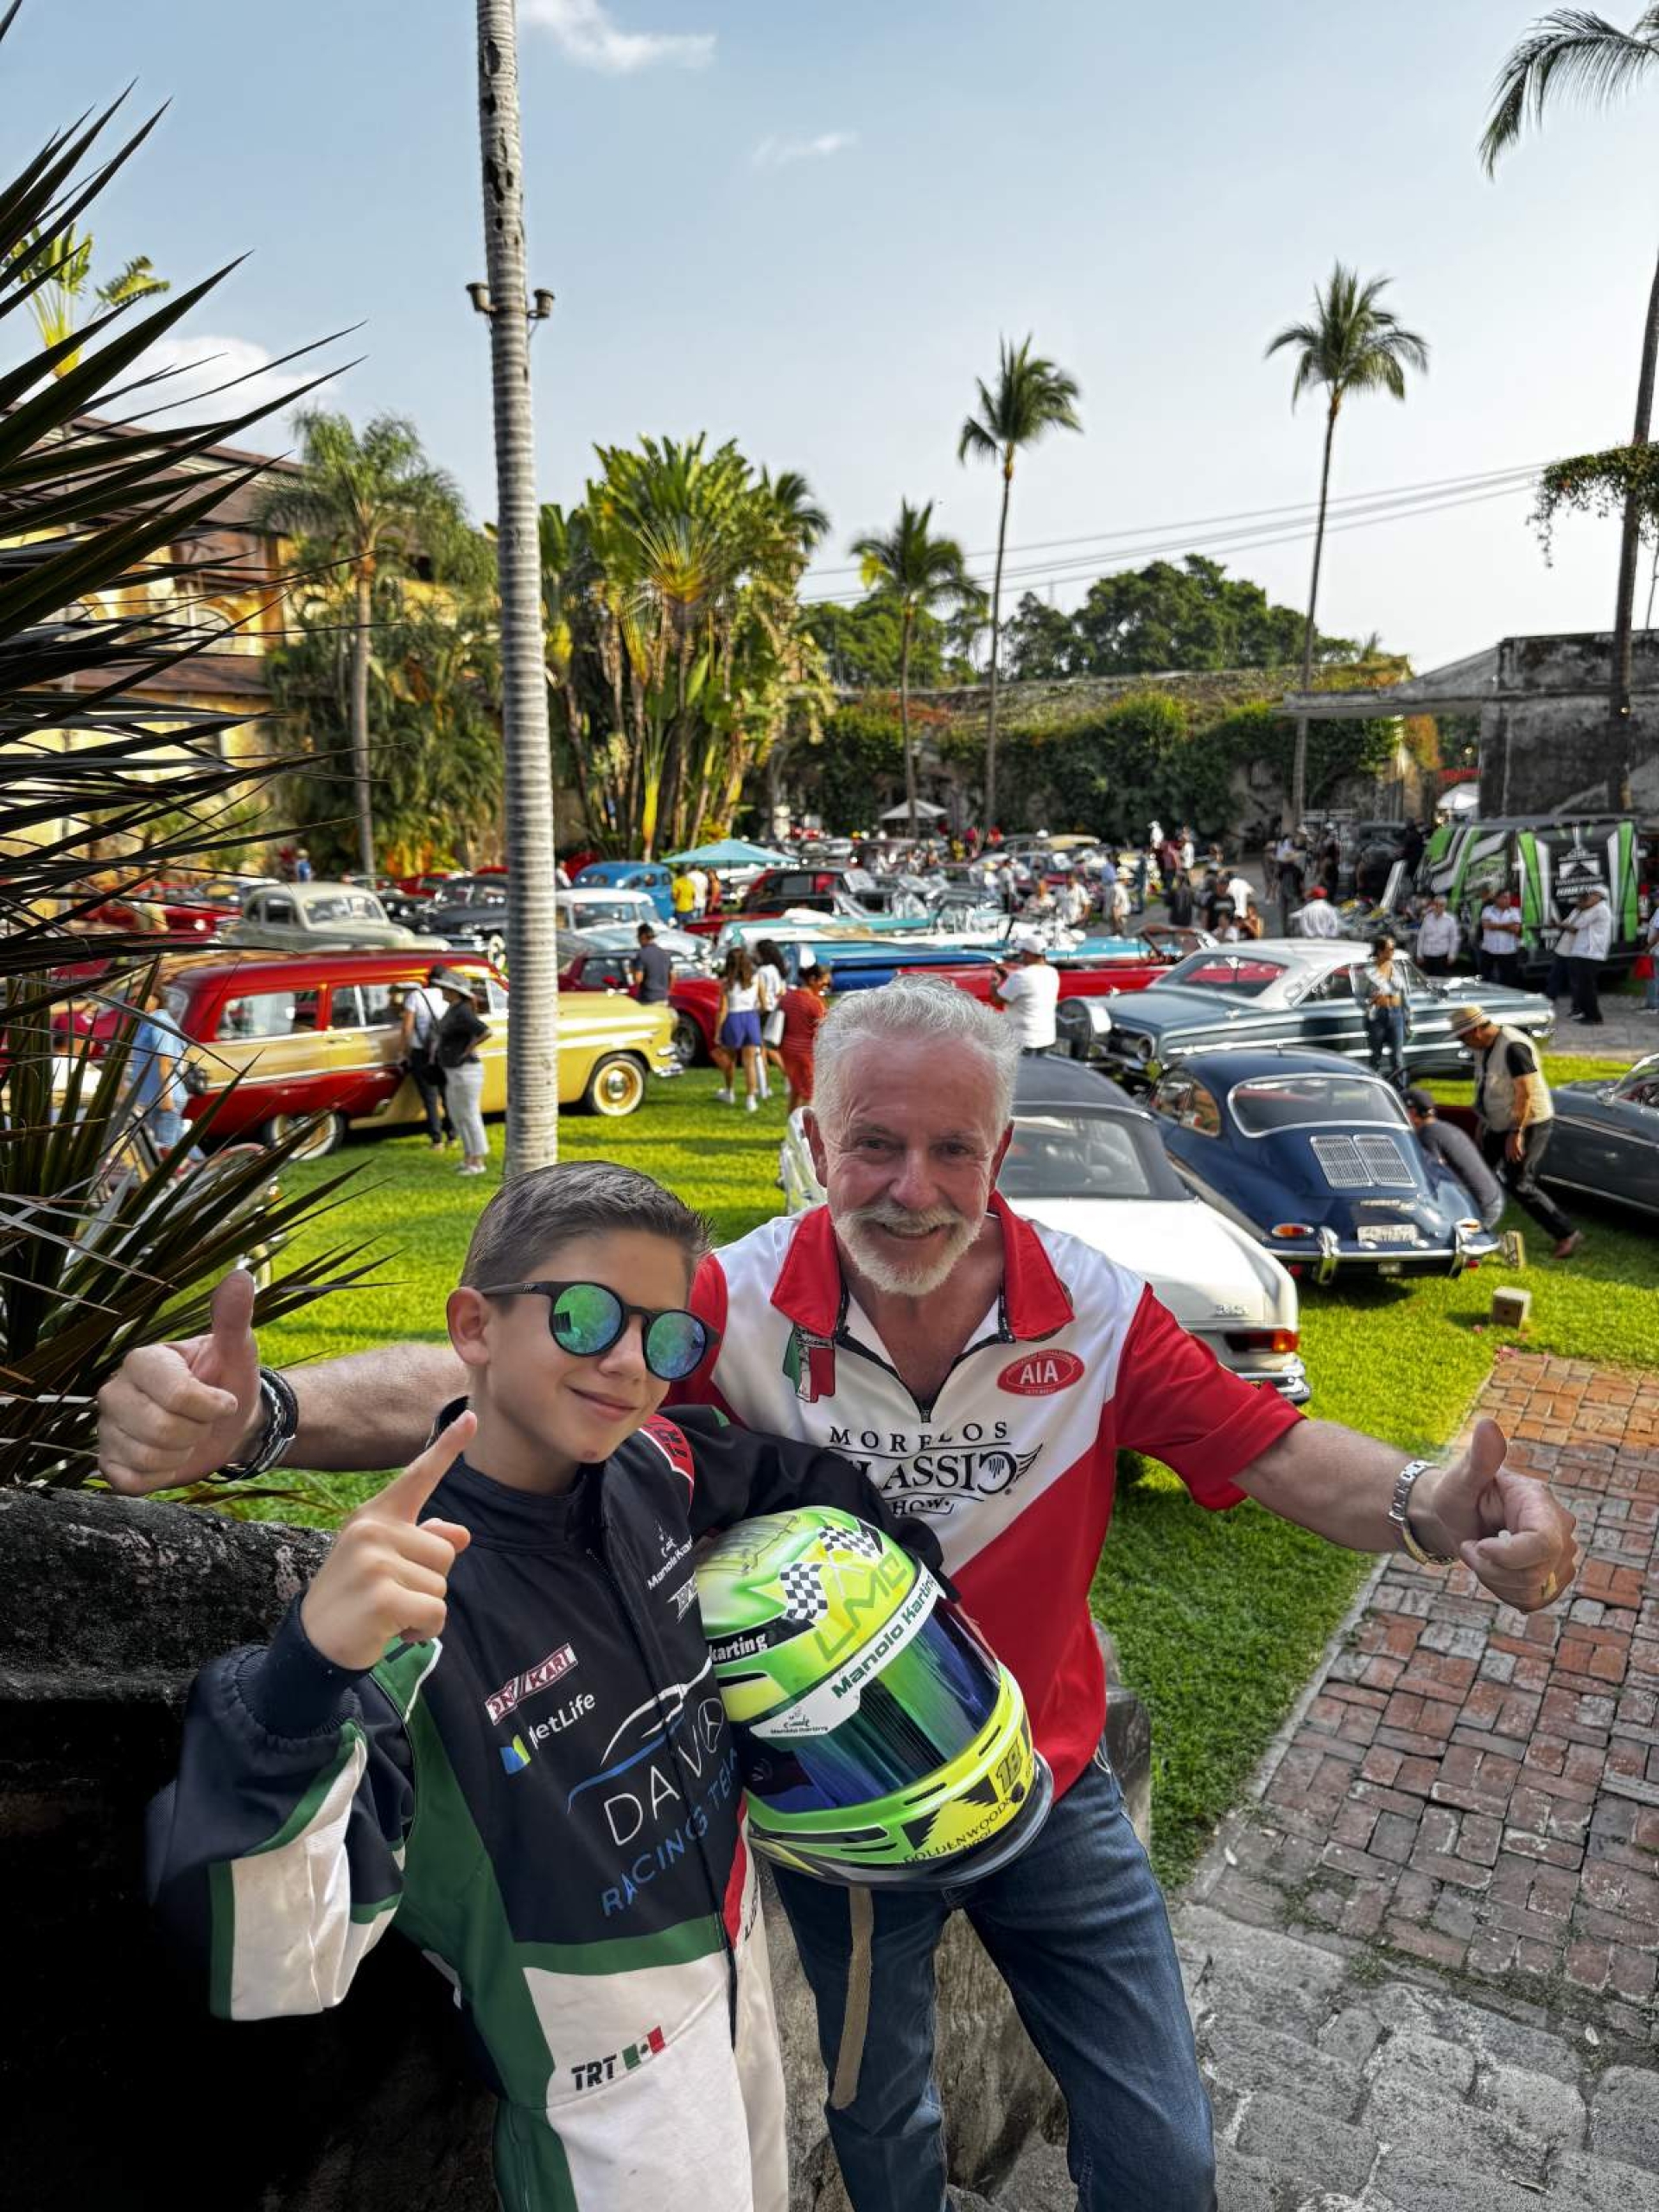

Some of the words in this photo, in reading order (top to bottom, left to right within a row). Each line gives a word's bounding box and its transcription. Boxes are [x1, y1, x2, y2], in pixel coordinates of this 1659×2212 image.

[1019, 1359, 1059, 1385] AIA
[830, 1624, 905, 1699] Manolo
[601, 1806, 709, 1917] RACING
[570, 2053, 617, 2091] TRT
